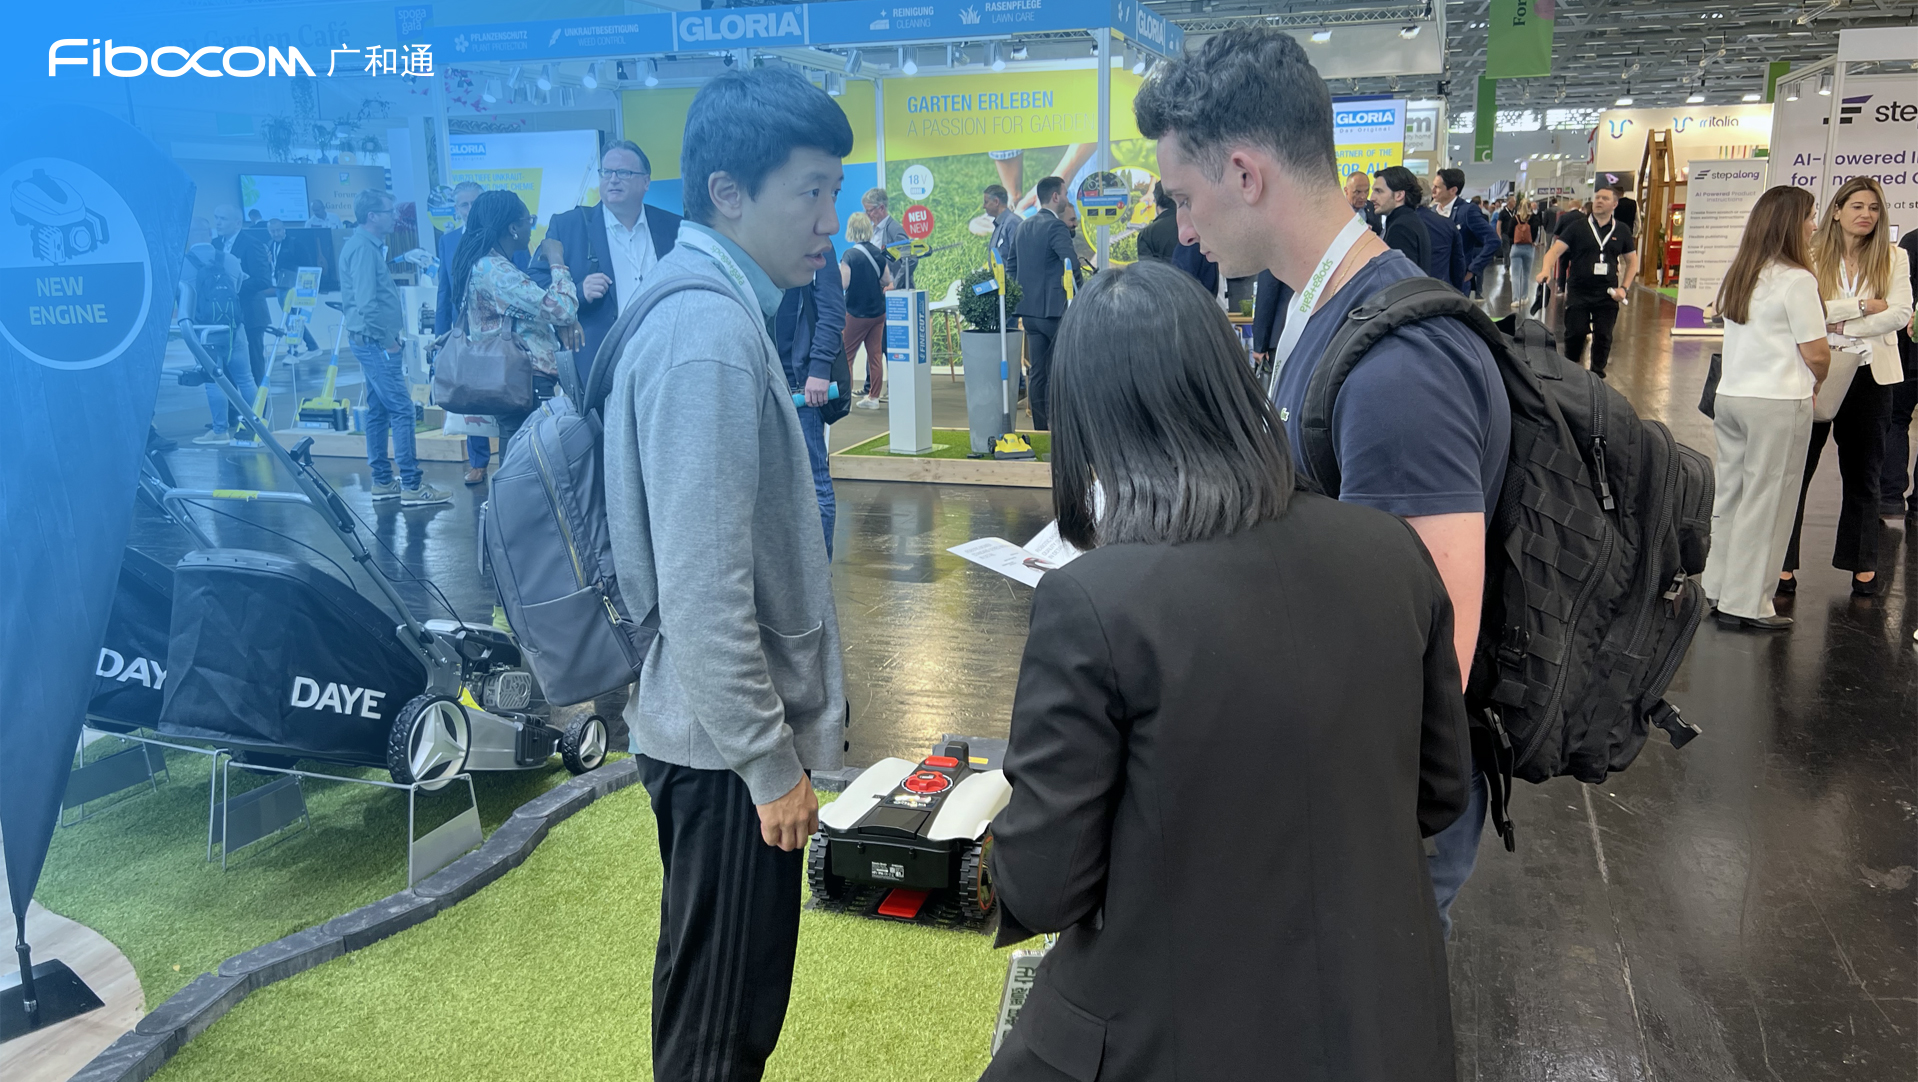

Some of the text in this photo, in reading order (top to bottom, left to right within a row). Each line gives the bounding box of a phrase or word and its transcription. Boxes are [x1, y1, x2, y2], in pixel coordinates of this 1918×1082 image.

[893, 6, 934, 18] REINIGUNG
[985, 0, 1042, 13] RASENPFLEGE
[398, 8, 427, 22] spoga
[992, 11, 1035, 24] LAWN CARE
[401, 18, 422, 35] gafa
[564, 23, 639, 37] UNKRAUTBESEITIGUNG
[896, 17, 931, 29] CLEANING
[1138, 9, 1164, 46] GLORIA
[298, 20, 350, 48] Café
[470, 30, 528, 42] PFLANZENSCHUTZ
[578, 35, 627, 47] WEED CONTROL
[472, 41, 528, 52] PLANT PROTECTION
[907, 90, 1054, 114] GARTEN ERLEBEN
[1336, 111, 1394, 125] GLORIA
[1875, 101, 1918, 124] ste
[907, 119, 918, 137] A
[922, 116, 986, 137] PASSION
[993, 115, 1023, 134] FOR
[450, 144, 486, 154] GLORIA
[1336, 148, 1393, 158] ARTNER OF THE
[1482, 150, 1491, 162] C
[1793, 150, 1906, 166] AI-owered
[908, 174, 928, 185] 18 V
[1711, 169, 1760, 181] stepalong
[1791, 172, 1817, 186] for
[325, 201, 352, 209] Garden
[908, 210, 927, 222] NEU
[909, 222, 929, 234] NEW
[36, 276, 84, 297] NEW
[1299, 258, 1334, 314] spoga+gafa
[29, 304, 108, 326] ENGINE
[95, 647, 167, 690] DAY
[290, 675, 387, 720] DAYE
